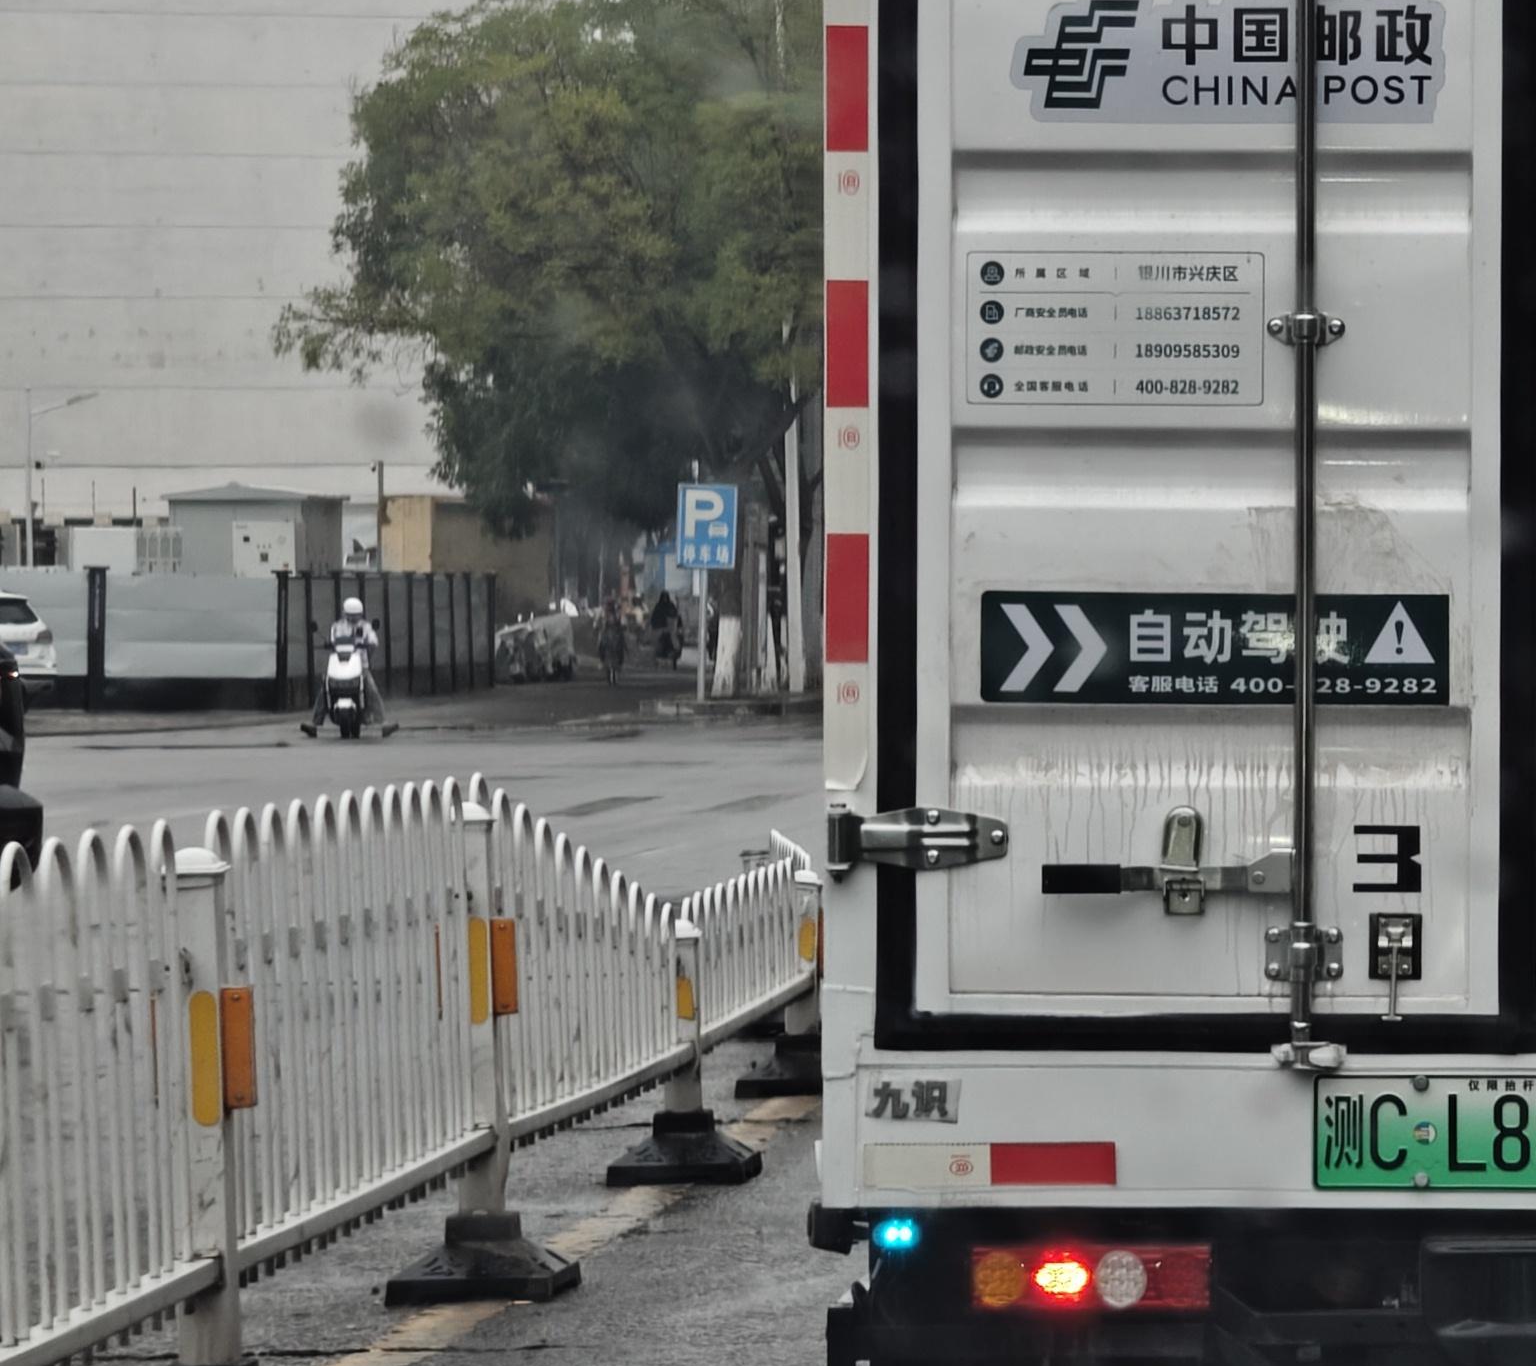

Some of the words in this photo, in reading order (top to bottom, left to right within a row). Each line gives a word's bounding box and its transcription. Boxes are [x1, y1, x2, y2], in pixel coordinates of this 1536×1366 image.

[1161, 4, 1433, 66] 中国邮政
[1161, 75, 1298, 106] CHINA
[1324, 75, 1433, 106] POST
[1138, 264, 1239, 283] 银川市兴庆区
[1135, 306, 1241, 321] 18863718572
[1135, 342, 1241, 359] 18909585309
[1135, 379, 1240, 396] 400-828-9282
[685, 489, 724, 538] P
[1128, 609, 1349, 665] 自动驾驶
[1128, 675, 1219, 694] 客服电话
[1230, 677, 1438, 694] 400-28-9282
[872, 1081, 948, 1119] 九识
